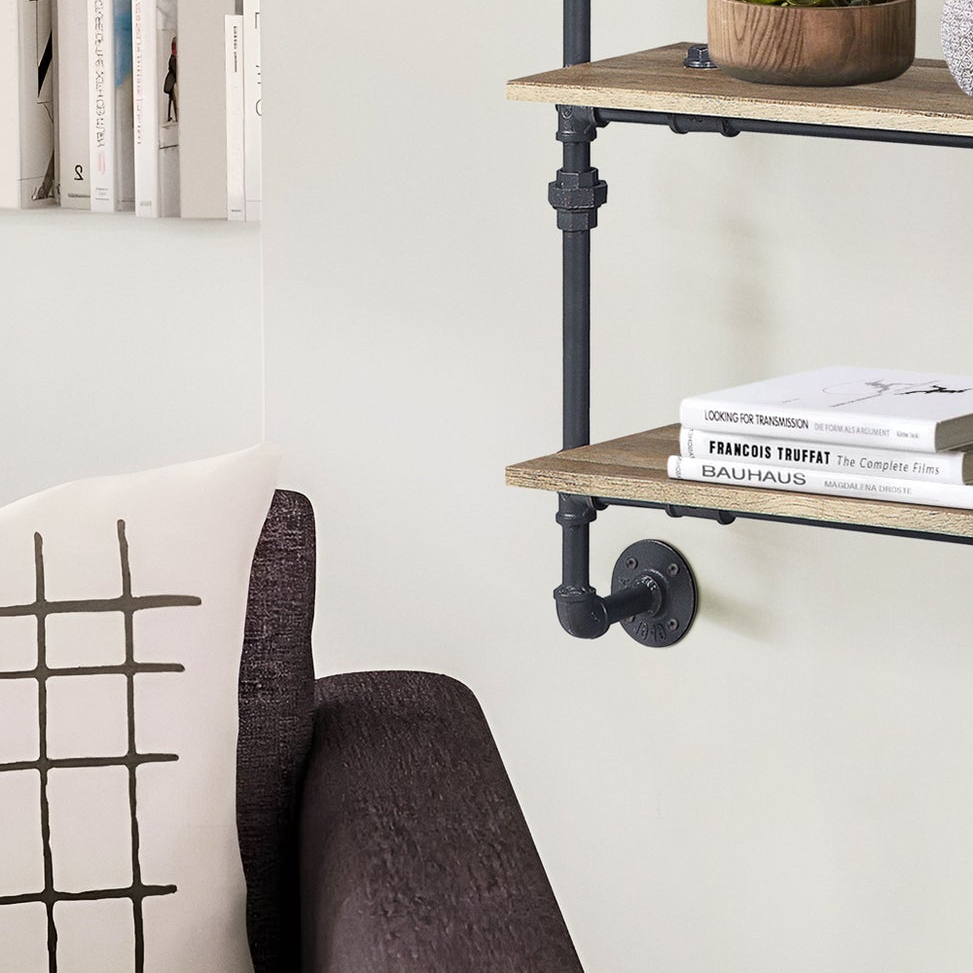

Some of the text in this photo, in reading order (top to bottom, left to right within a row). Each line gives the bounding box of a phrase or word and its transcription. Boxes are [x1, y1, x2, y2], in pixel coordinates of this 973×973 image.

[704, 410, 809, 429] LOOKING FOR TRANSMISSION
[825, 423, 844, 432] FORM
[856, 426, 890, 437] ARGUMENT
[709, 440, 940, 475] FRANCOIS TRUFFAT The Complete Films
[702, 464, 807, 486] BAUHAUS
[824, 480, 912, 495] MAGDALENA DROSTE
